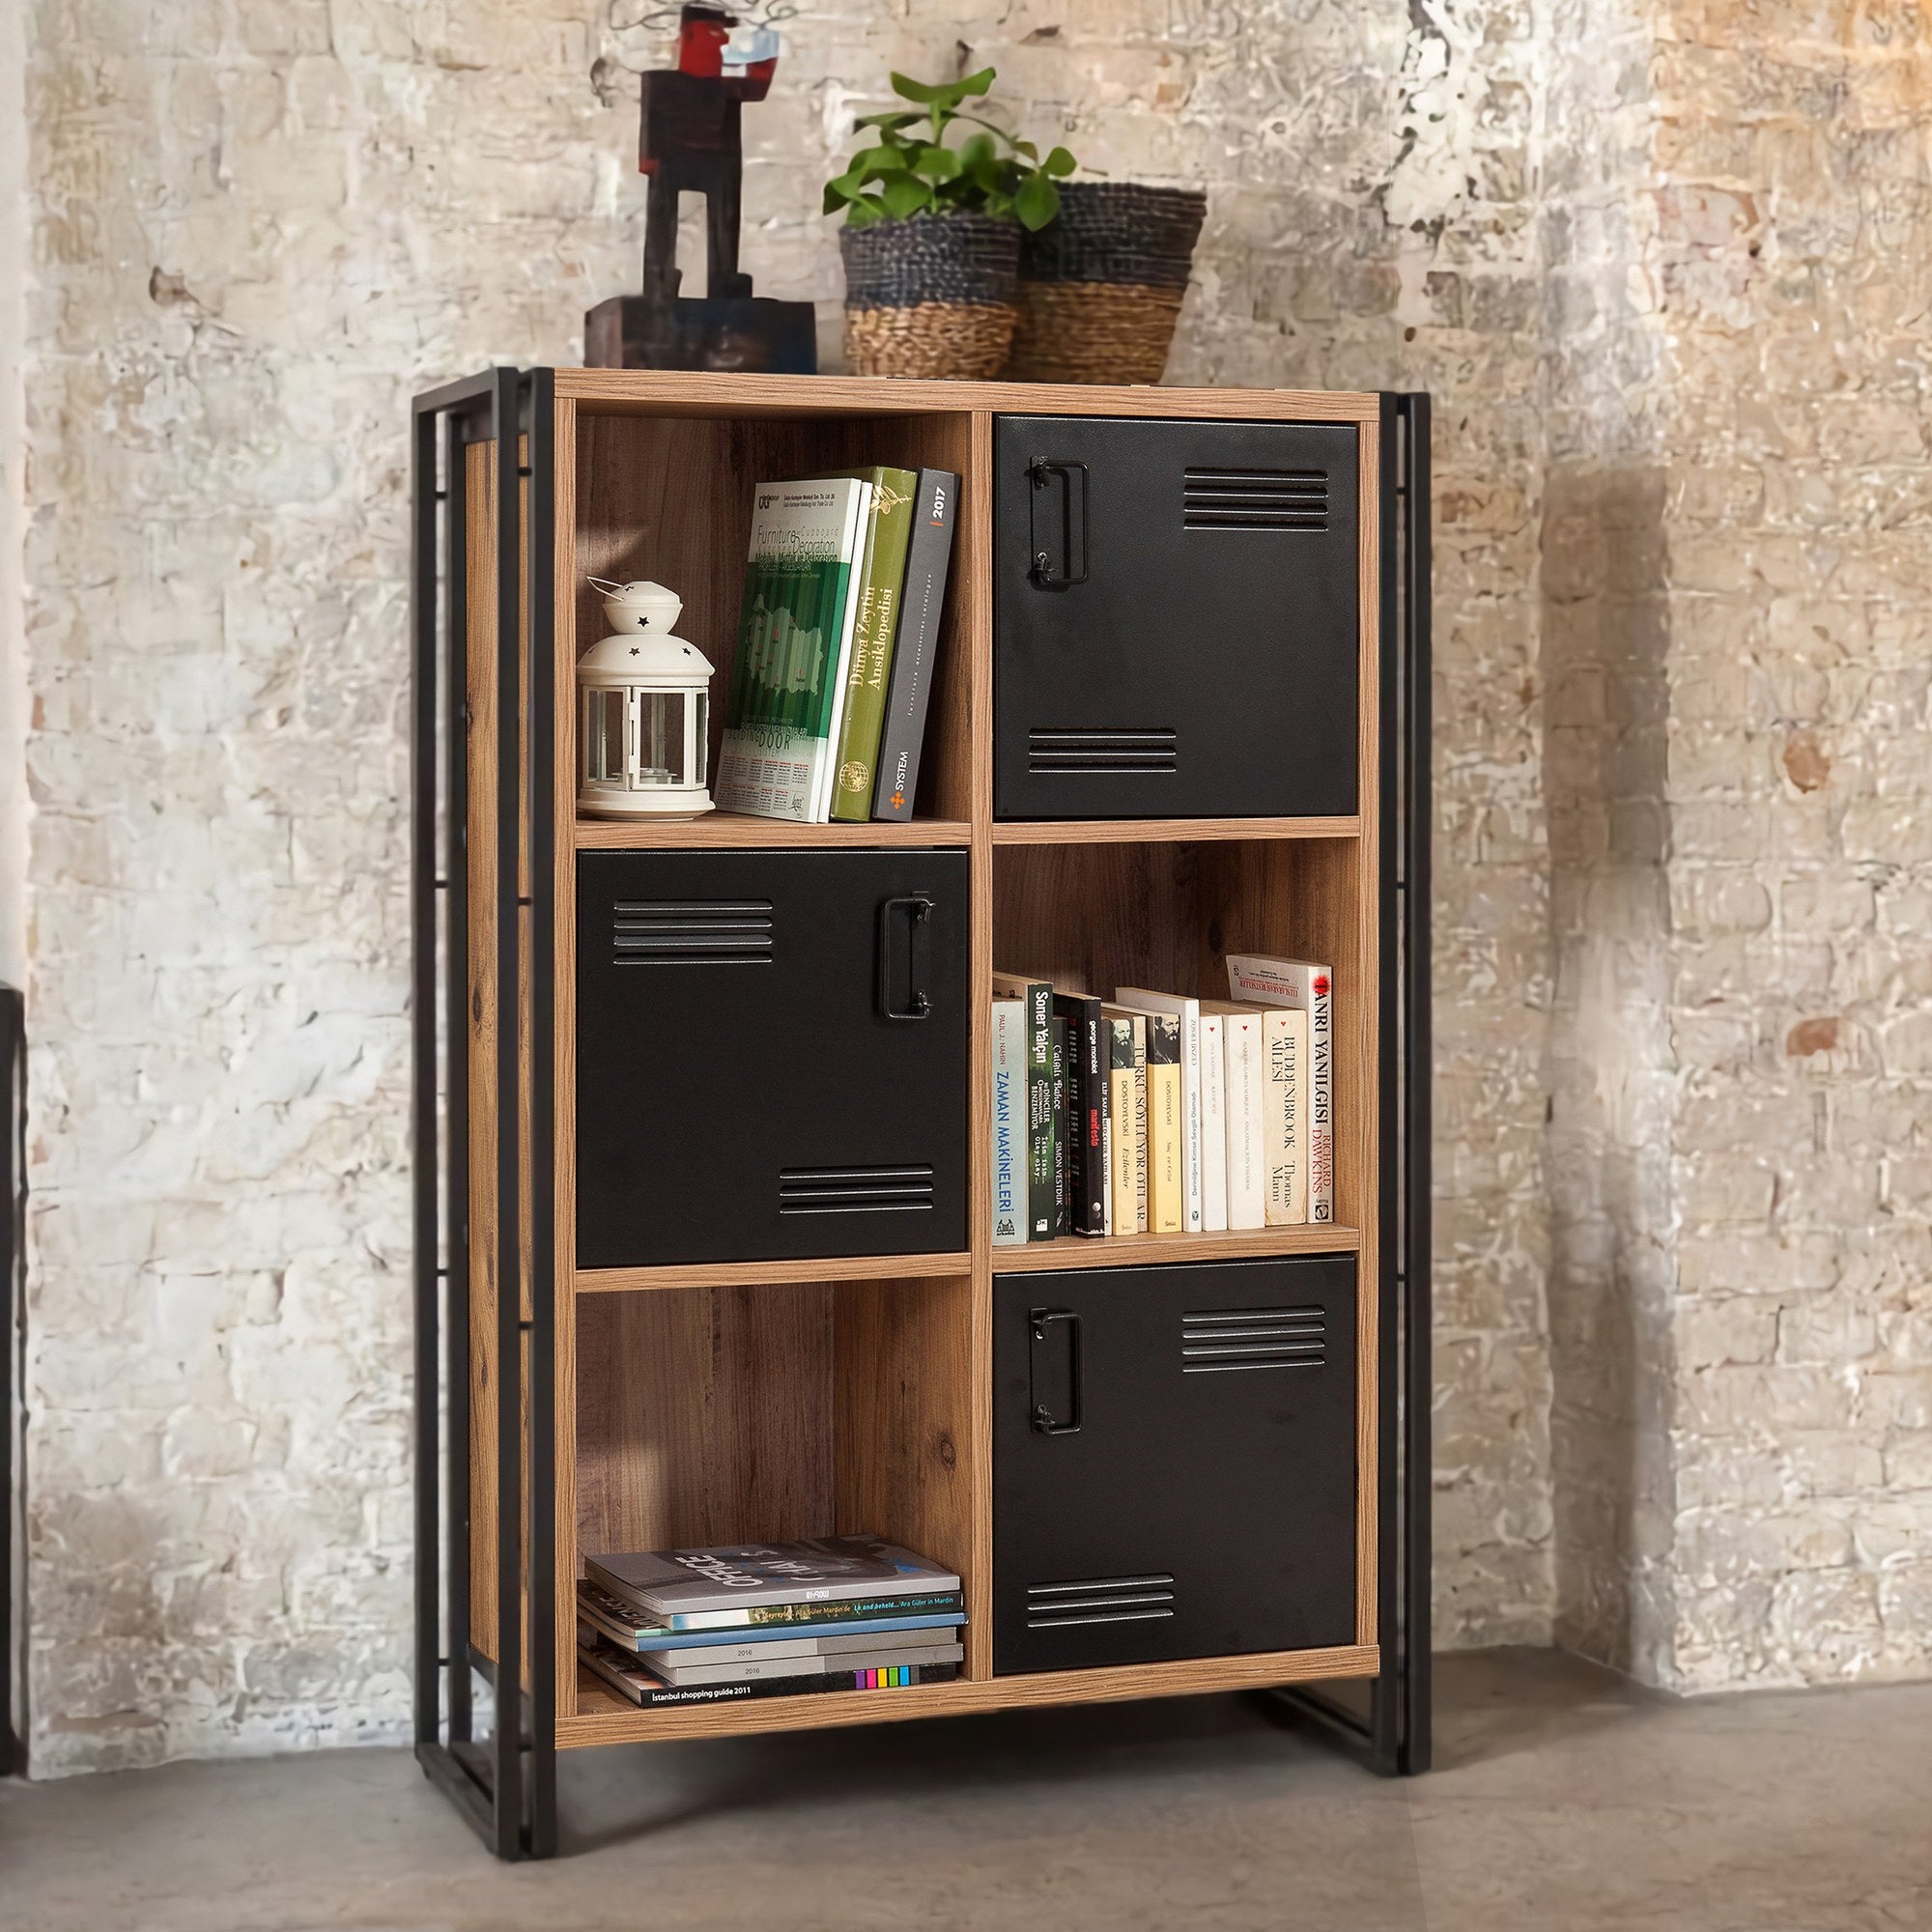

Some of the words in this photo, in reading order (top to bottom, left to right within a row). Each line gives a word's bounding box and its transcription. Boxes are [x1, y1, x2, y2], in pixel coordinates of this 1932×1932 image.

[932, 486, 946, 520] 2017
[757, 525, 796, 544] Furniture
[793, 535, 836, 554] Decoration
[856, 585, 876, 635] Zeytin
[867, 587, 893, 691] Ansiklopedisi
[848, 639, 871, 688] Dünya
[758, 732, 790, 750] DOOR
[895, 751, 909, 791] SYSTEM
[1036, 991, 1049, 1027] Soner
[1315, 980, 1328, 1033] TANRI
[1032, 1029, 1049, 1064] Yalçın
[1134, 1043, 1147, 1093] TÜRKÜ
[1315, 1039, 1328, 1123] YANILGISI
[996, 1071, 1009, 1122] ZAMAN
[1284, 1037, 1295, 1150] BUDDENBROOK
[1091, 1109, 1100, 1147] manifesto
[997, 1126, 1014, 1212] MAKİNELERİ
[1122, 1148, 1130, 1189] Ezilenler
[1312, 1129, 1322, 1194] DAWKINS
[1322, 1134, 1332, 1187] RICHARD
[1272, 1166, 1284, 1202] Mann
[1284, 1160, 1295, 1208] Thomas
[675, 1554, 764, 1587] OFFICE
[740, 1549, 826, 1581] CHAIS
[911, 1599, 926, 1607] Güler
[680, 1690, 713, 1700] shopping
[713, 1688, 734, 1698] guide
[733, 1686, 752, 1694] 2011
